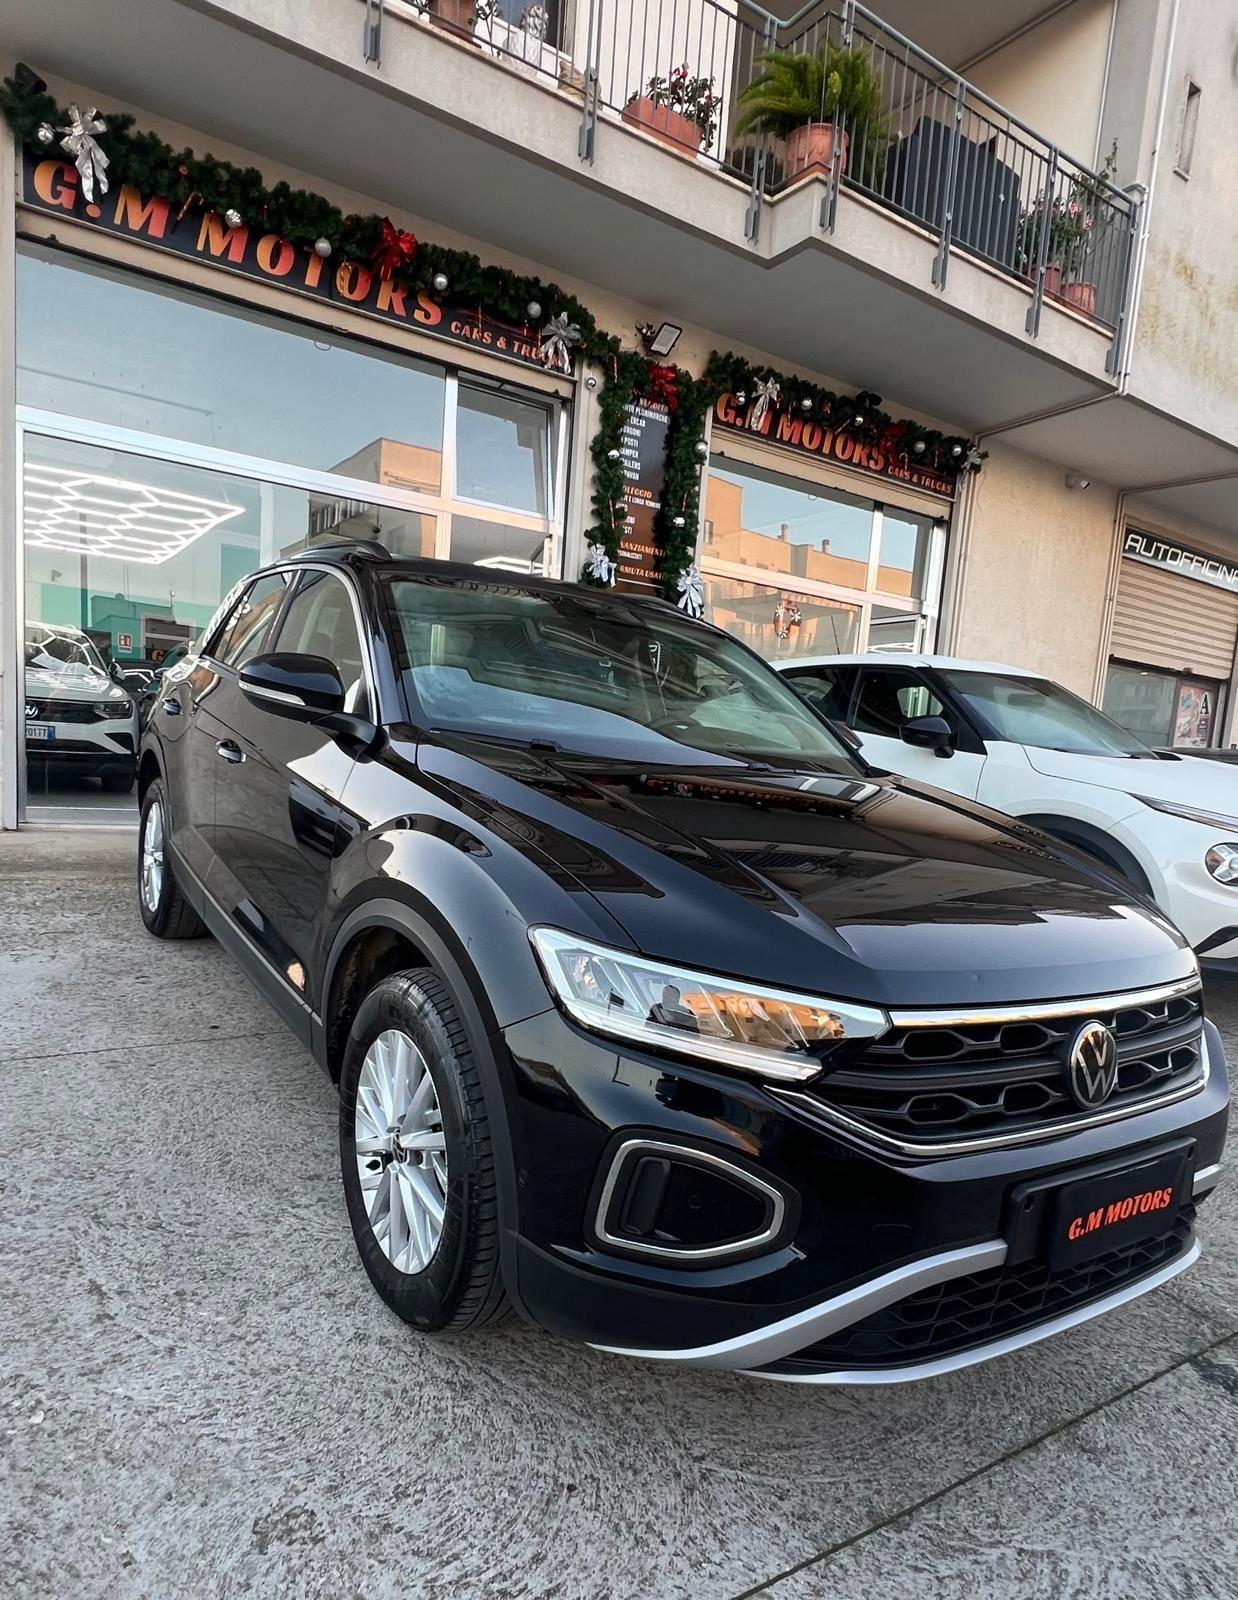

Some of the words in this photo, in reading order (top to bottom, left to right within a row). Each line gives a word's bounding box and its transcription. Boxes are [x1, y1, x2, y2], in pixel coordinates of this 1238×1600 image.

[33, 159, 170, 239] G.M
[196, 210, 442, 327] MOTORS
[450, 320, 493, 345] CARS
[496, 335, 508, 350] &
[512, 340, 564, 368] TRUK
[622, 403, 634, 414] UTO
[627, 416, 646, 427] ERCAR
[776, 413, 885, 472] MOTORS
[887, 465, 911, 480] CARS
[912, 473, 919, 483] &
[920, 475, 953, 494] TRUCKS
[645, 569, 664, 581] USAT
[1068, 1207, 1103, 1241] G.M
[1104, 1186, 1174, 1226] MOTORS
